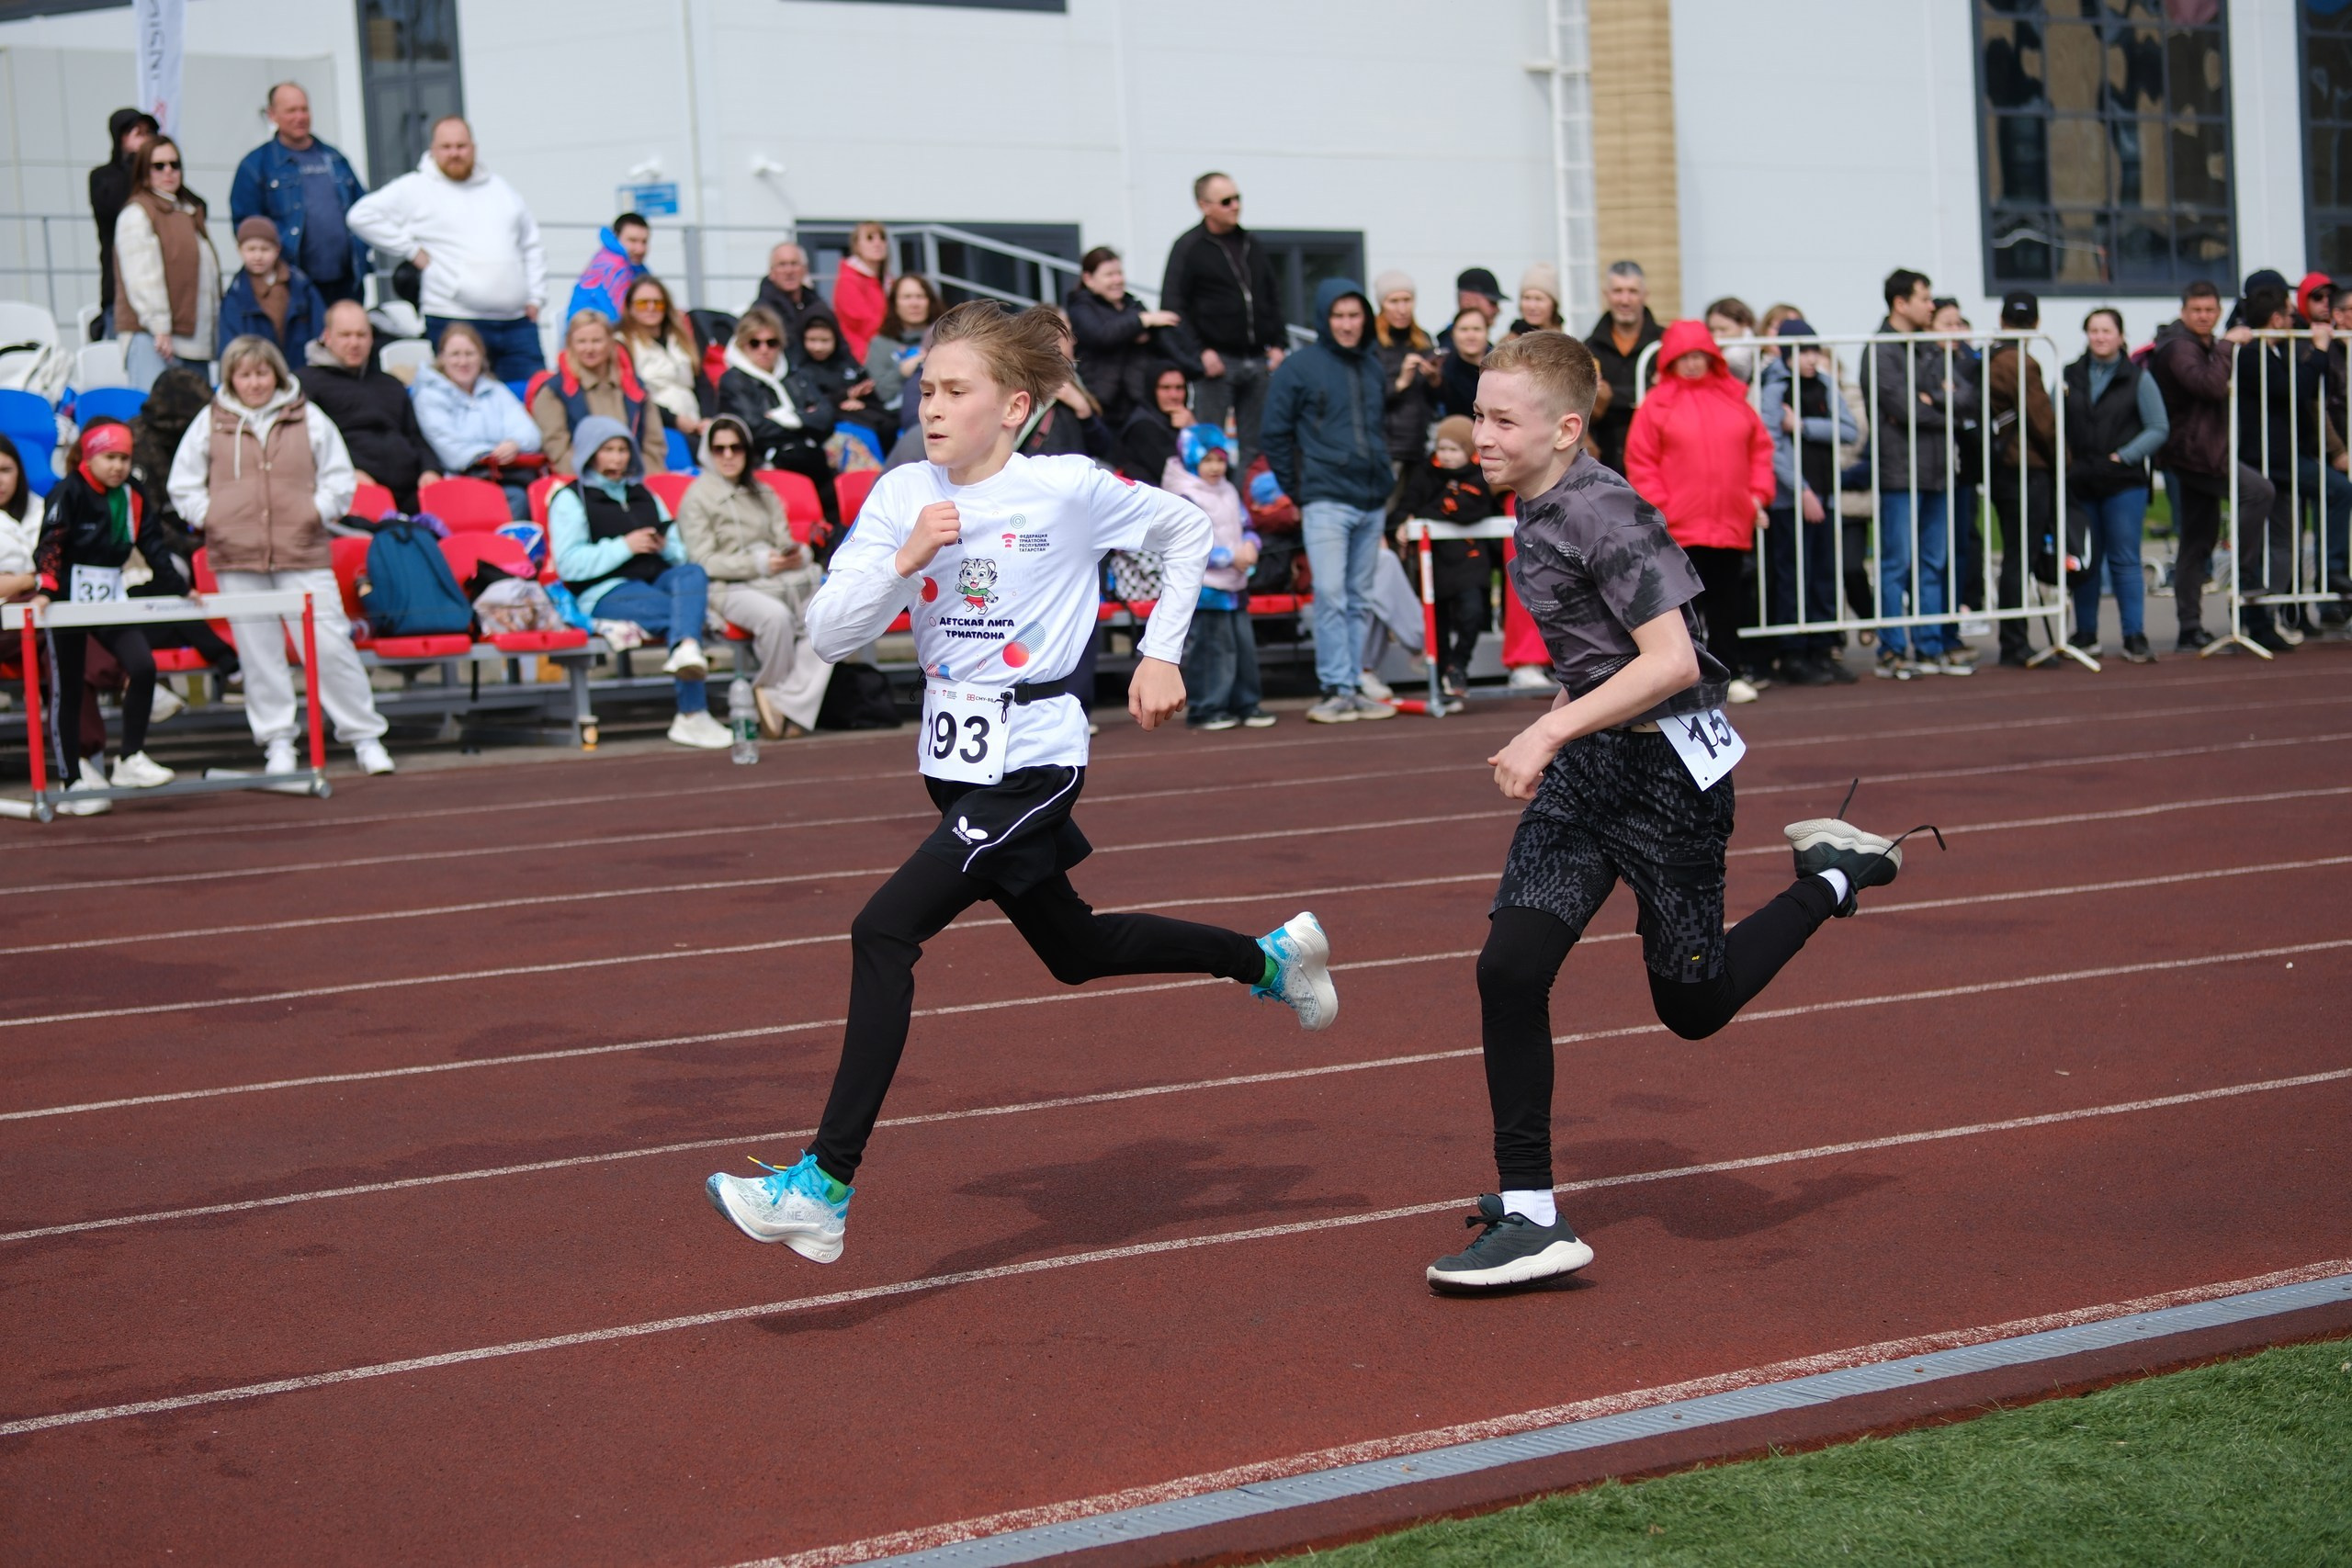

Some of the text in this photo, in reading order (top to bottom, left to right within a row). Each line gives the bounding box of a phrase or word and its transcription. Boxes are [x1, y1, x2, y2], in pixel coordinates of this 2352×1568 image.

[939, 617, 984, 626] ДЕТСКАЯ
[945, 630, 1005, 639] ТРИАТЛОНА
[927, 708, 990, 763] 193
[1688, 710, 1732, 760] 15
[952, 827, 973, 845] Butterfly
